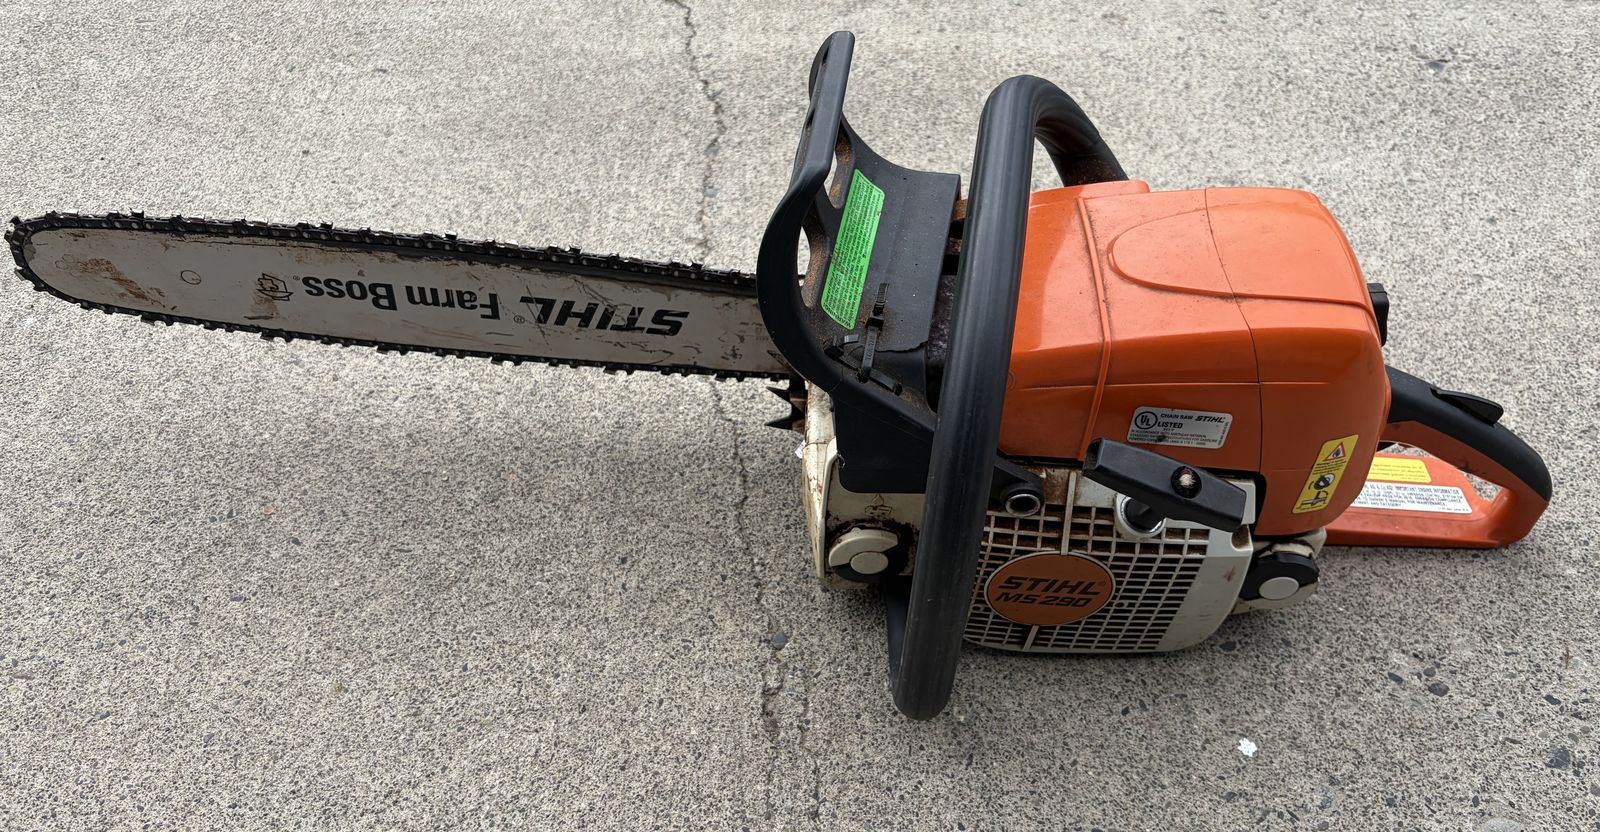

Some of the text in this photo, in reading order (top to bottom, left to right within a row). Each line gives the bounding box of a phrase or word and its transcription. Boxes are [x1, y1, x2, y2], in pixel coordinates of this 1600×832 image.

[301, 276, 690, 336] STIHL Farm Boss
[1140, 415, 1151, 426] UL
[1157, 421, 1183, 429] LISTED
[998, 576, 1100, 595] STIHL
[995, 592, 1093, 607] MS 290
